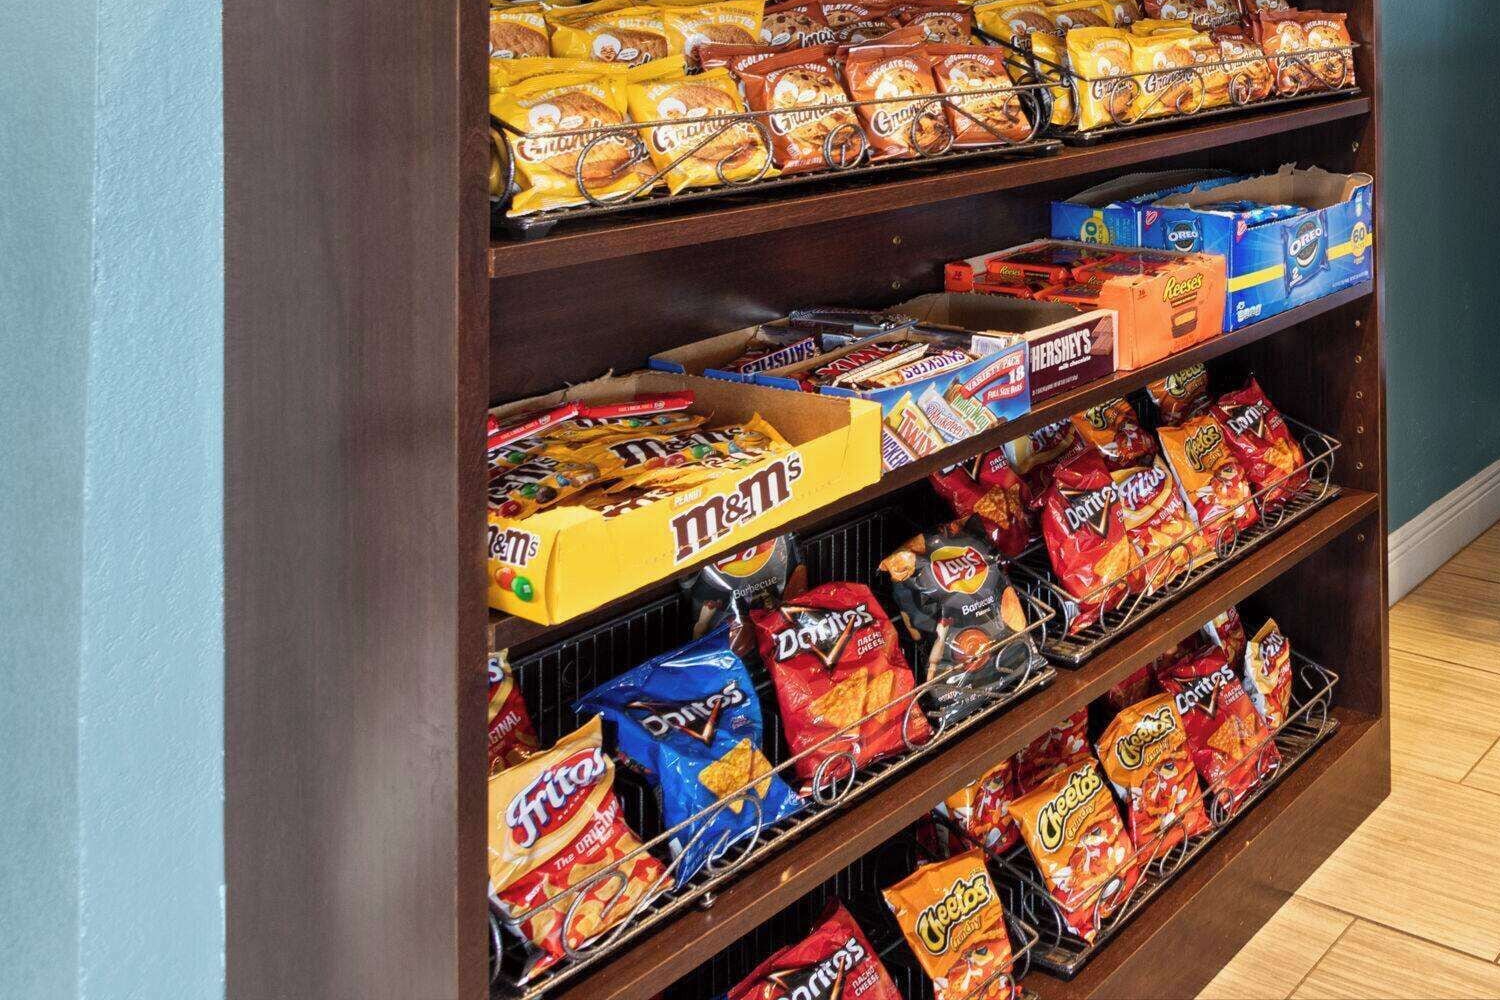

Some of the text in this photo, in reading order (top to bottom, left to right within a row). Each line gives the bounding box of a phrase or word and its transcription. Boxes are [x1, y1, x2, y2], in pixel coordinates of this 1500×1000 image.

[804, 62, 828, 74] CHIP
[1168, 230, 1199, 242] OREO
[1289, 227, 1322, 257] OREO
[1163, 273, 1204, 303] Reese's
[904, 350, 966, 379] SNICKERS
[1030, 328, 1092, 373] HERSHEY'S
[965, 362, 1000, 392] VARIETY
[1008, 364, 1026, 385] 18
[897, 407, 939, 458] TWIX
[1118, 465, 1166, 511] Fritos
[732, 575, 778, 600] Barbecue
[777, 604, 874, 661] Doritos
[1175, 662, 1235, 715] Doritos
[641, 681, 743, 737] Doritos
[489, 709, 523, 745] GINAL
[1117, 708, 1175, 768] Cheetos
[504, 747, 606, 849] Fritos
[557, 788, 587, 821] BRAND
[1038, 765, 1102, 851] Cheetos
[553, 852, 576, 871] The
[915, 876, 990, 953] Cheetos
[778, 937, 865, 1000] oritos
[851, 965, 876, 989] NACHO
[854, 973, 880, 997] CHEESE
